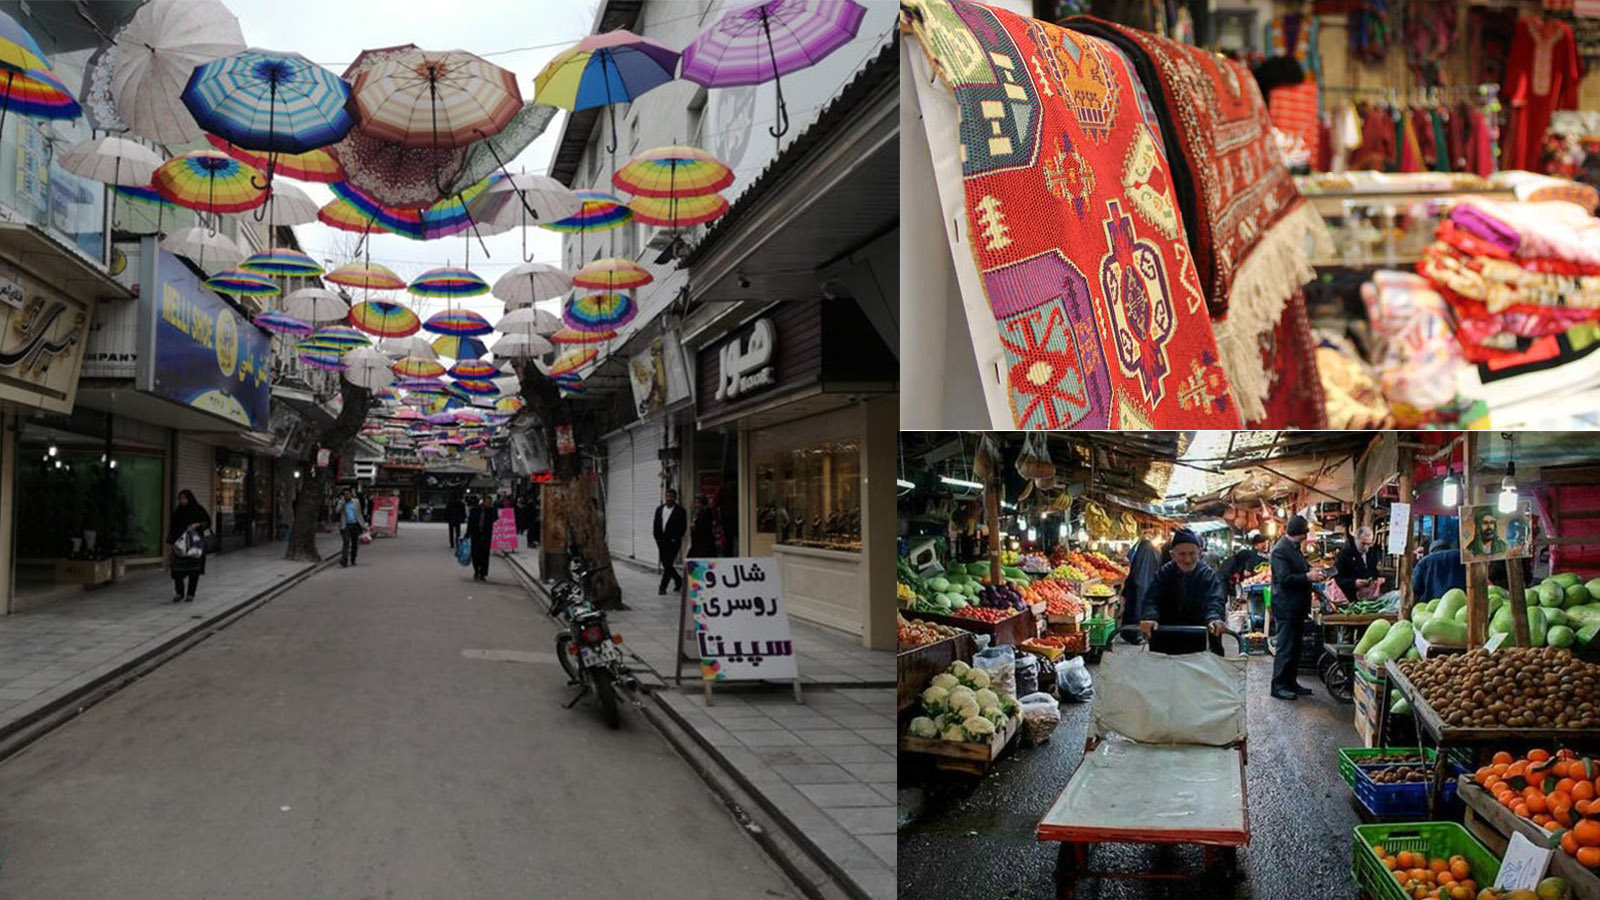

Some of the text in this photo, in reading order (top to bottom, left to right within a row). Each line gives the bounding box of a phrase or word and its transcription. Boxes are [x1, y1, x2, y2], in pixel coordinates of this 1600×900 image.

[162, 281, 190, 337] MELLI
[85, 353, 137, 363] MPANY
[704, 563, 766, 588] شال و
[702, 596, 778, 617] روسری
[698, 632, 793, 667] سپیتا
